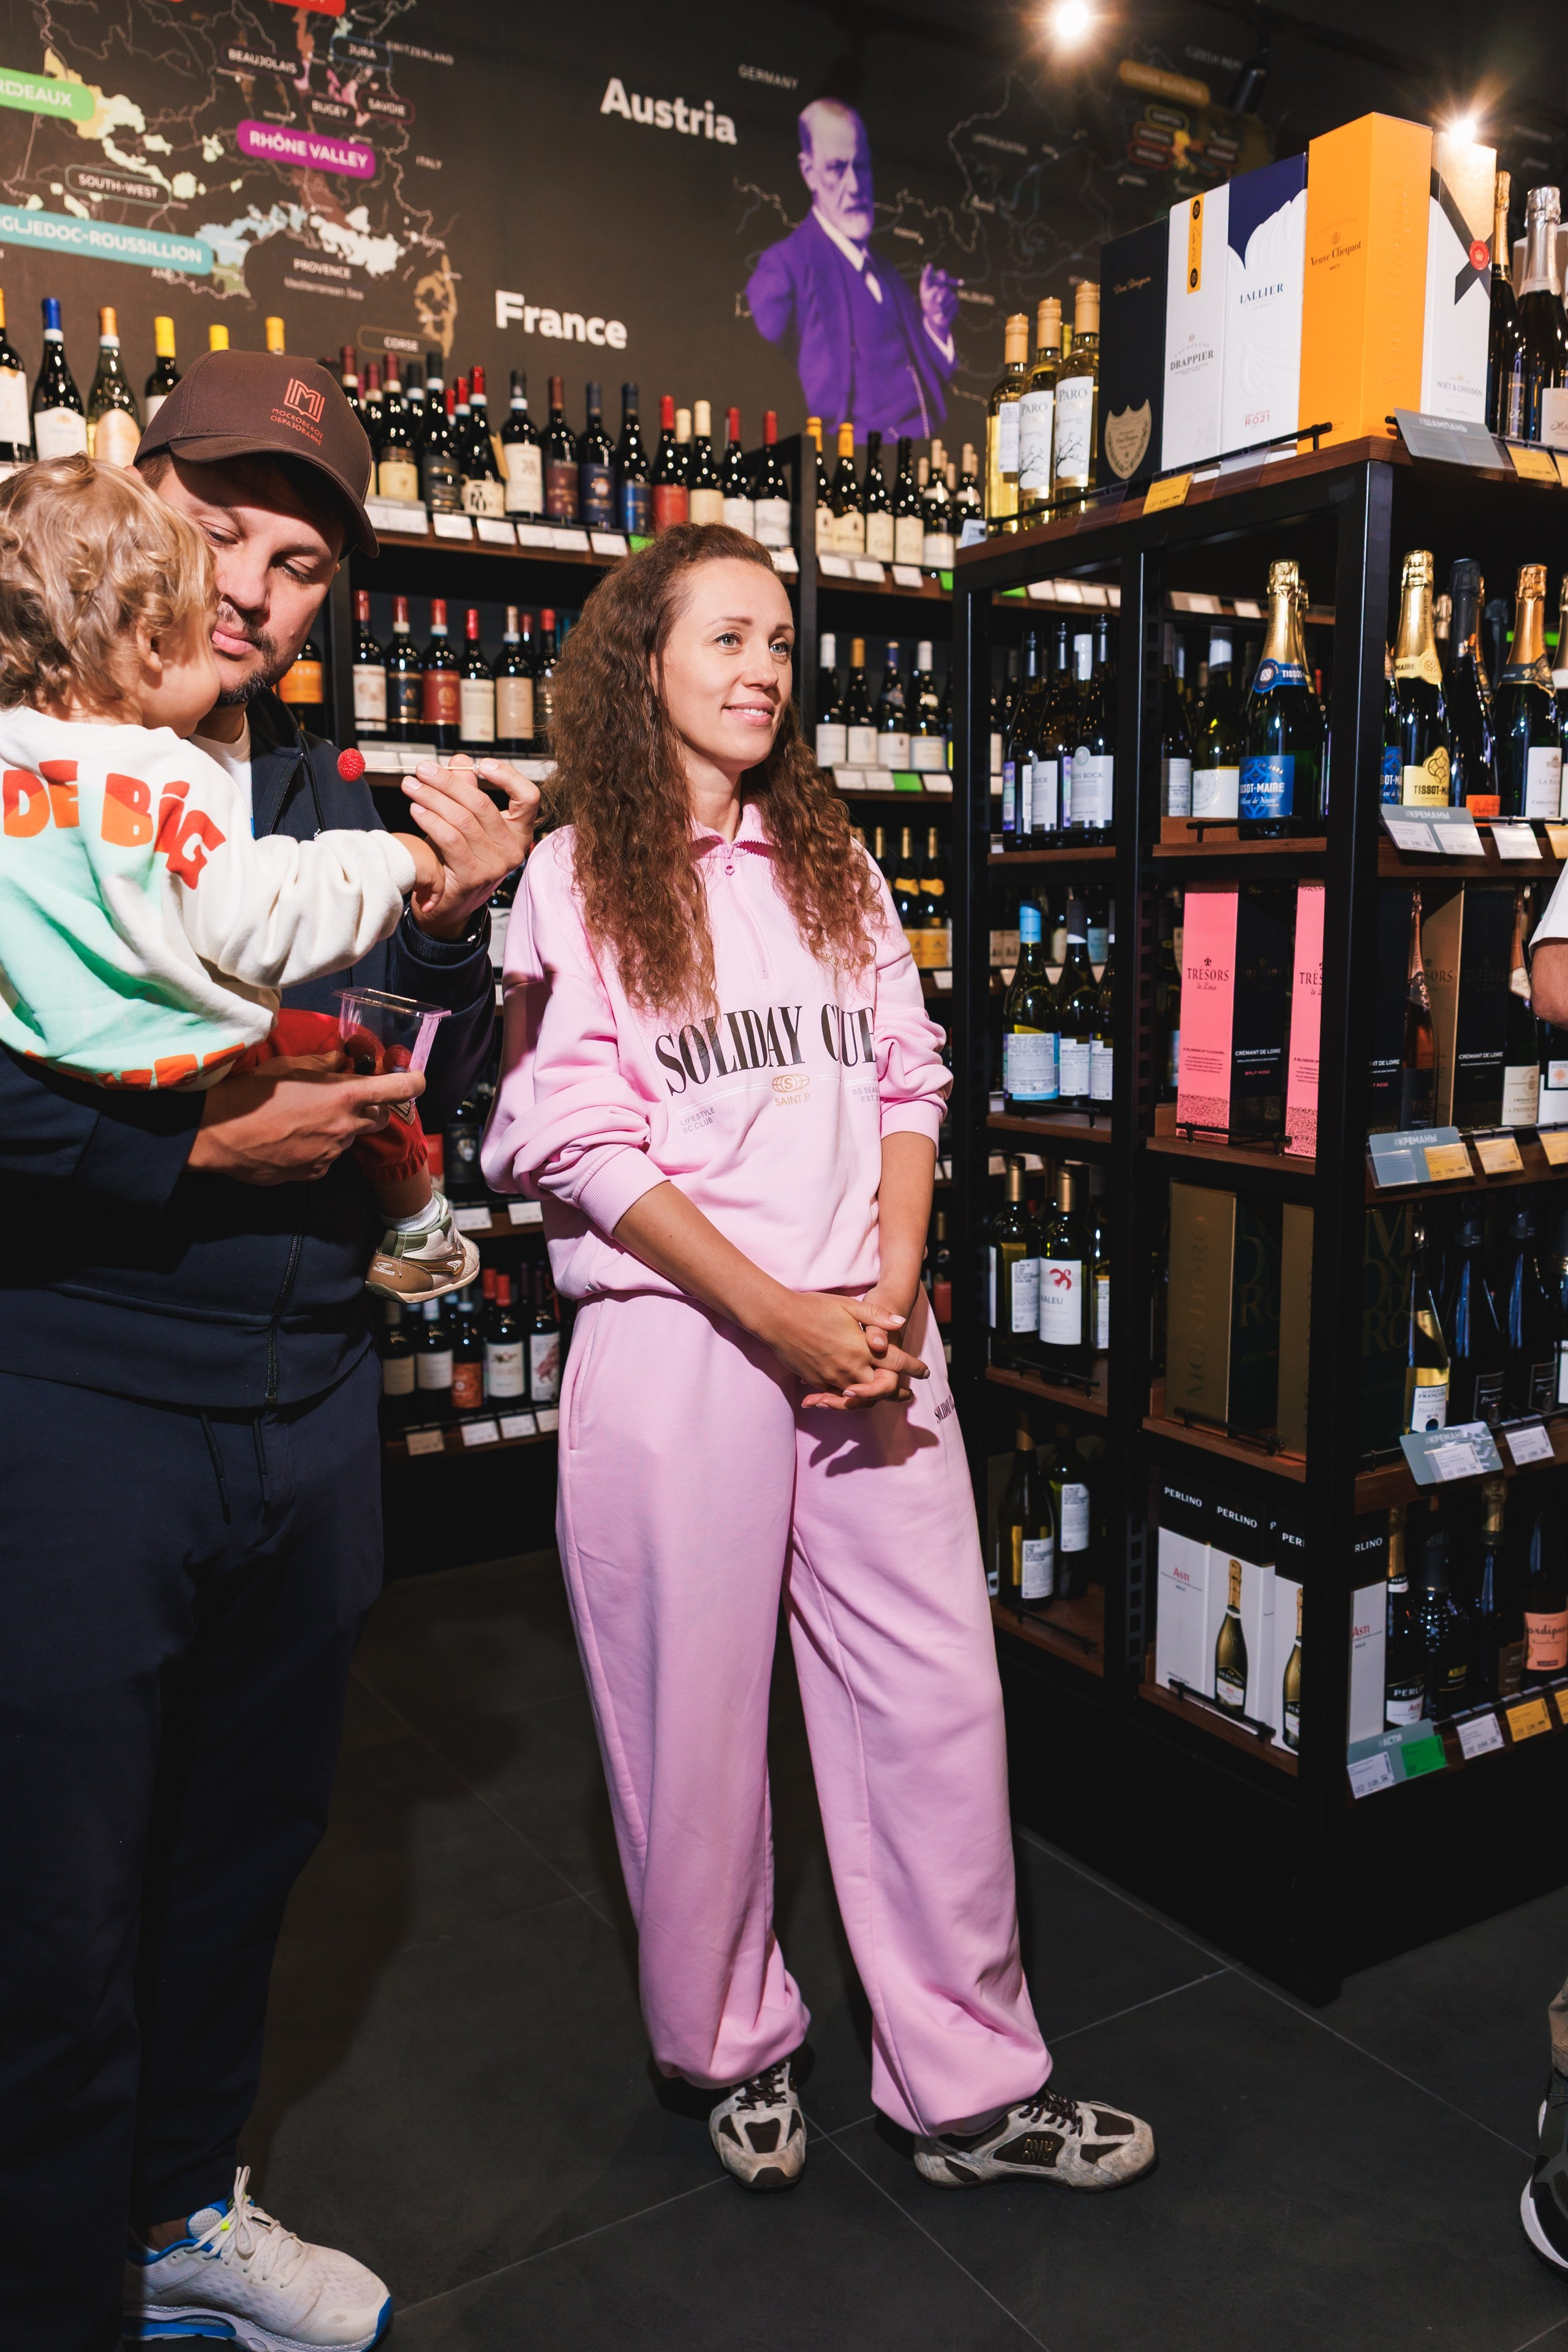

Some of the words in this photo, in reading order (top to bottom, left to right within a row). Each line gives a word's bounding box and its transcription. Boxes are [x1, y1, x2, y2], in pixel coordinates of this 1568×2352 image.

[228, 48, 298, 75] BEAUJOLAIS
[349, 43, 377, 59] JURA
[739, 64, 799, 91] GERMANY
[312, 100, 349, 119] BUGEY
[368, 98, 406, 117] SAVOIE
[600, 78, 737, 145] Austria
[249, 130, 307, 157] RHÔNE
[309, 142, 369, 170] VALLEY
[78, 173, 159, 199] SOUTH-WEST
[1332, 241, 1361, 258] Clicquot
[293, 258, 352, 280] PROVENCE
[1240, 283, 1284, 304] LALLIER
[495, 289, 627, 349] France
[1170, 350, 1214, 371] DRAPPIER
[1059, 387, 1087, 402] PARO
[1021, 401, 1048, 417] PARO
[270, 416, 322, 446] ОБРАЗОВАНИЕ
[272, 409, 324, 439] МОСКОВСКОЕ
[1187, 966, 1229, 982] TRÉSORS
[655, 1005, 805, 1096] SOLIDAY
[1235, 1048, 1259, 1057] CRÉMANT
[775, 1092, 810, 1107] SAINT.P
[680, 1106, 715, 1126] LIFESTYLE
[683, 1125, 693, 1134] SC
[695, 1117, 714, 1131] CLUB
[1394, 1134, 1438, 1147] #КРЕМАНЫ
[1164, 1486, 1202, 1508] PERLINO
[1216, 1506, 1257, 1529] PERLINO
[1024, 2138, 1054, 2152] miu
